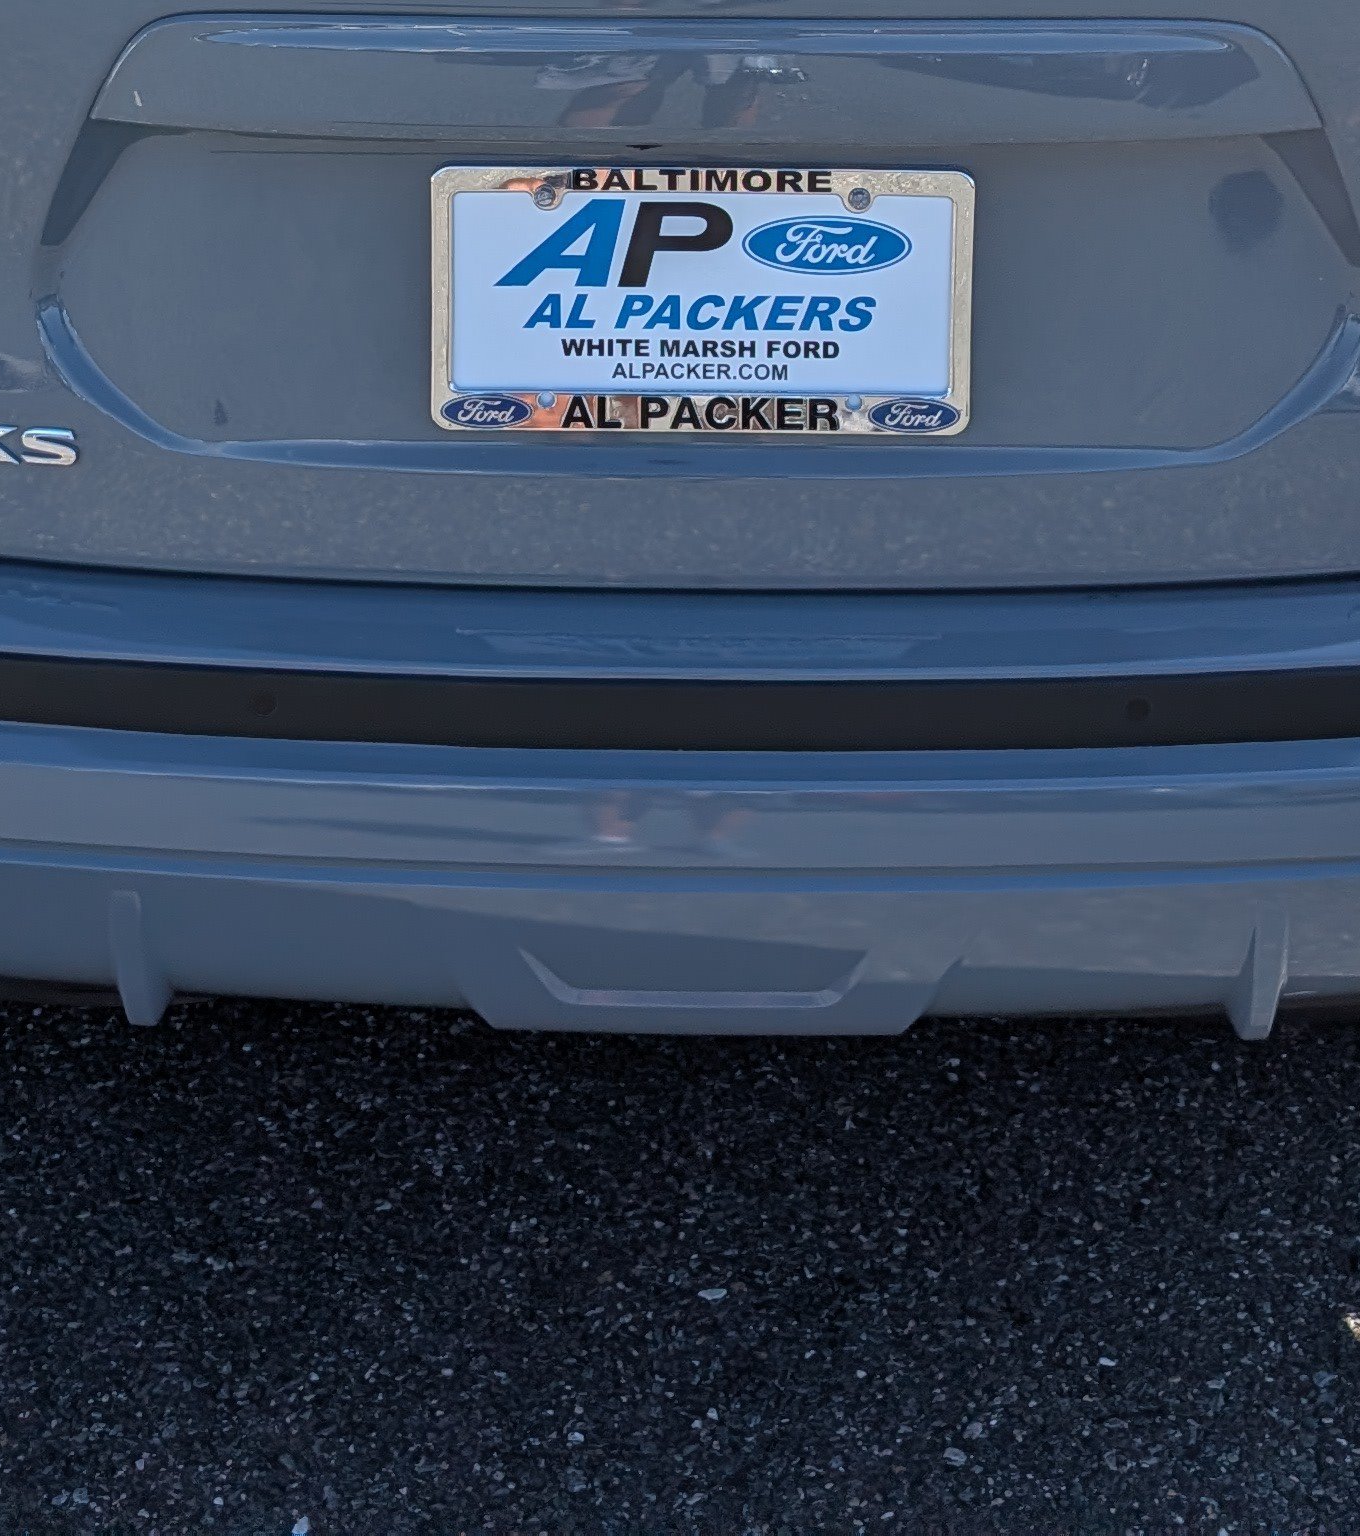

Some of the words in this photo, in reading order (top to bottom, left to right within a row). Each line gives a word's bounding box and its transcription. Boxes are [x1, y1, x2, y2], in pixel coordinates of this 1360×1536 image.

[572, 168, 834, 193] BALTIMORE
[494, 199, 733, 288] AP
[776, 223, 876, 266] Ford
[523, 293, 600, 329] AL
[615, 294, 877, 332] PACKERS
[561, 338, 650, 358] WHITE
[660, 339, 757, 359] MARSH
[767, 340, 840, 359] FORD
[611, 362, 788, 381] ALPACKER.COM
[456, 400, 524, 427] Ford
[562, 396, 622, 429] AL
[643, 397, 840, 431] PACKER
[883, 402, 946, 430] Ford
